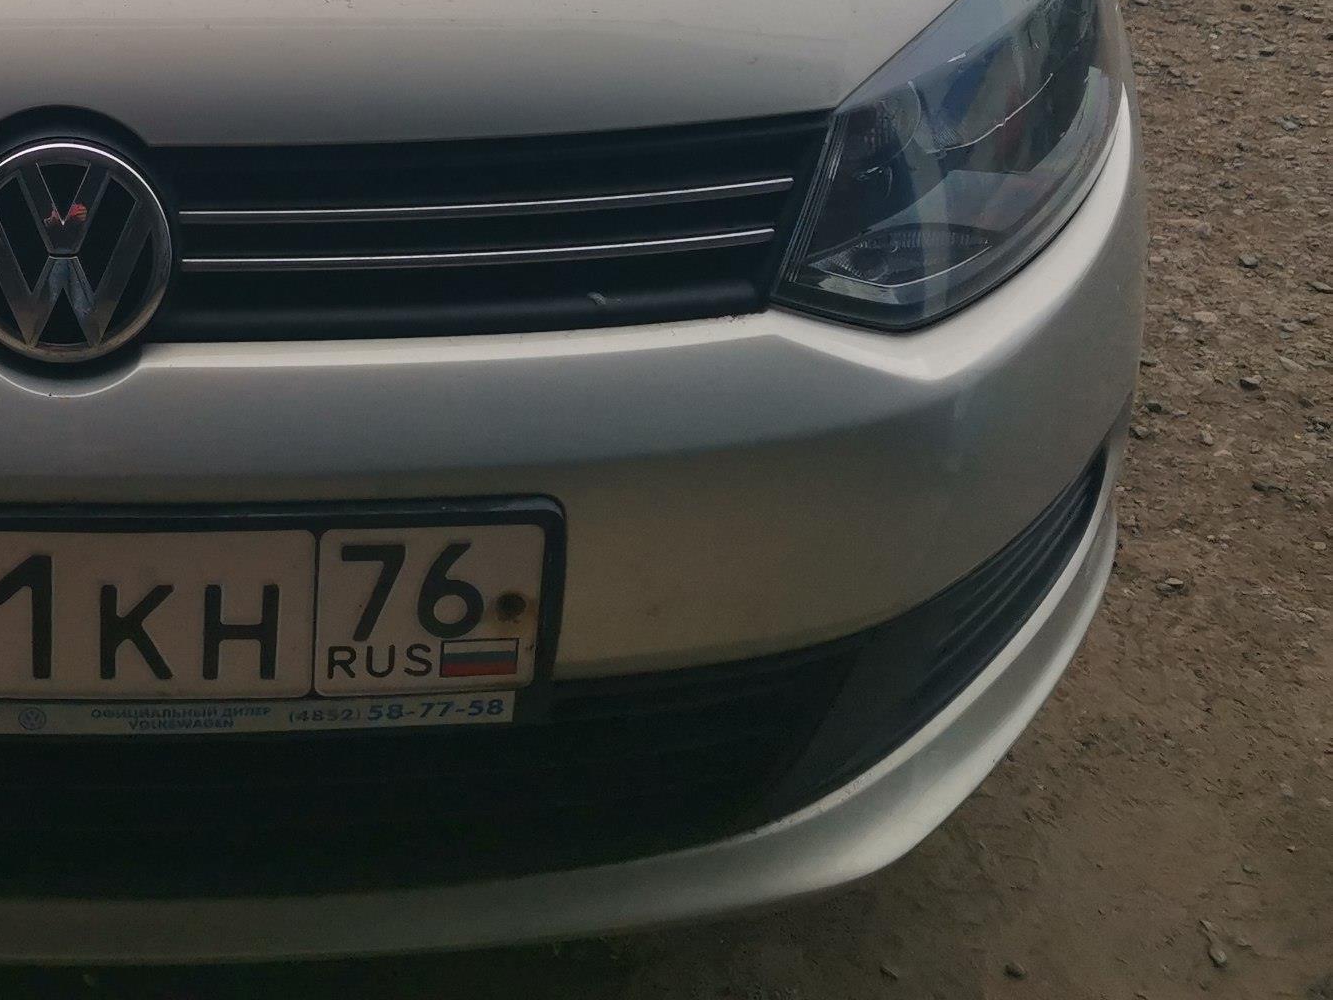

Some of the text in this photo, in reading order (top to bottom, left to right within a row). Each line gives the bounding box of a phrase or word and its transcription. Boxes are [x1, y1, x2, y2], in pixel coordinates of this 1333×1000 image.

[341, 543, 484, 641] 76
[325, 641, 434, 680] RUS
[90, 706, 272, 720] ОФИЦИАЛЬНЫЙ ДИЛЕР
[367, 698, 504, 722] 58-77-58
